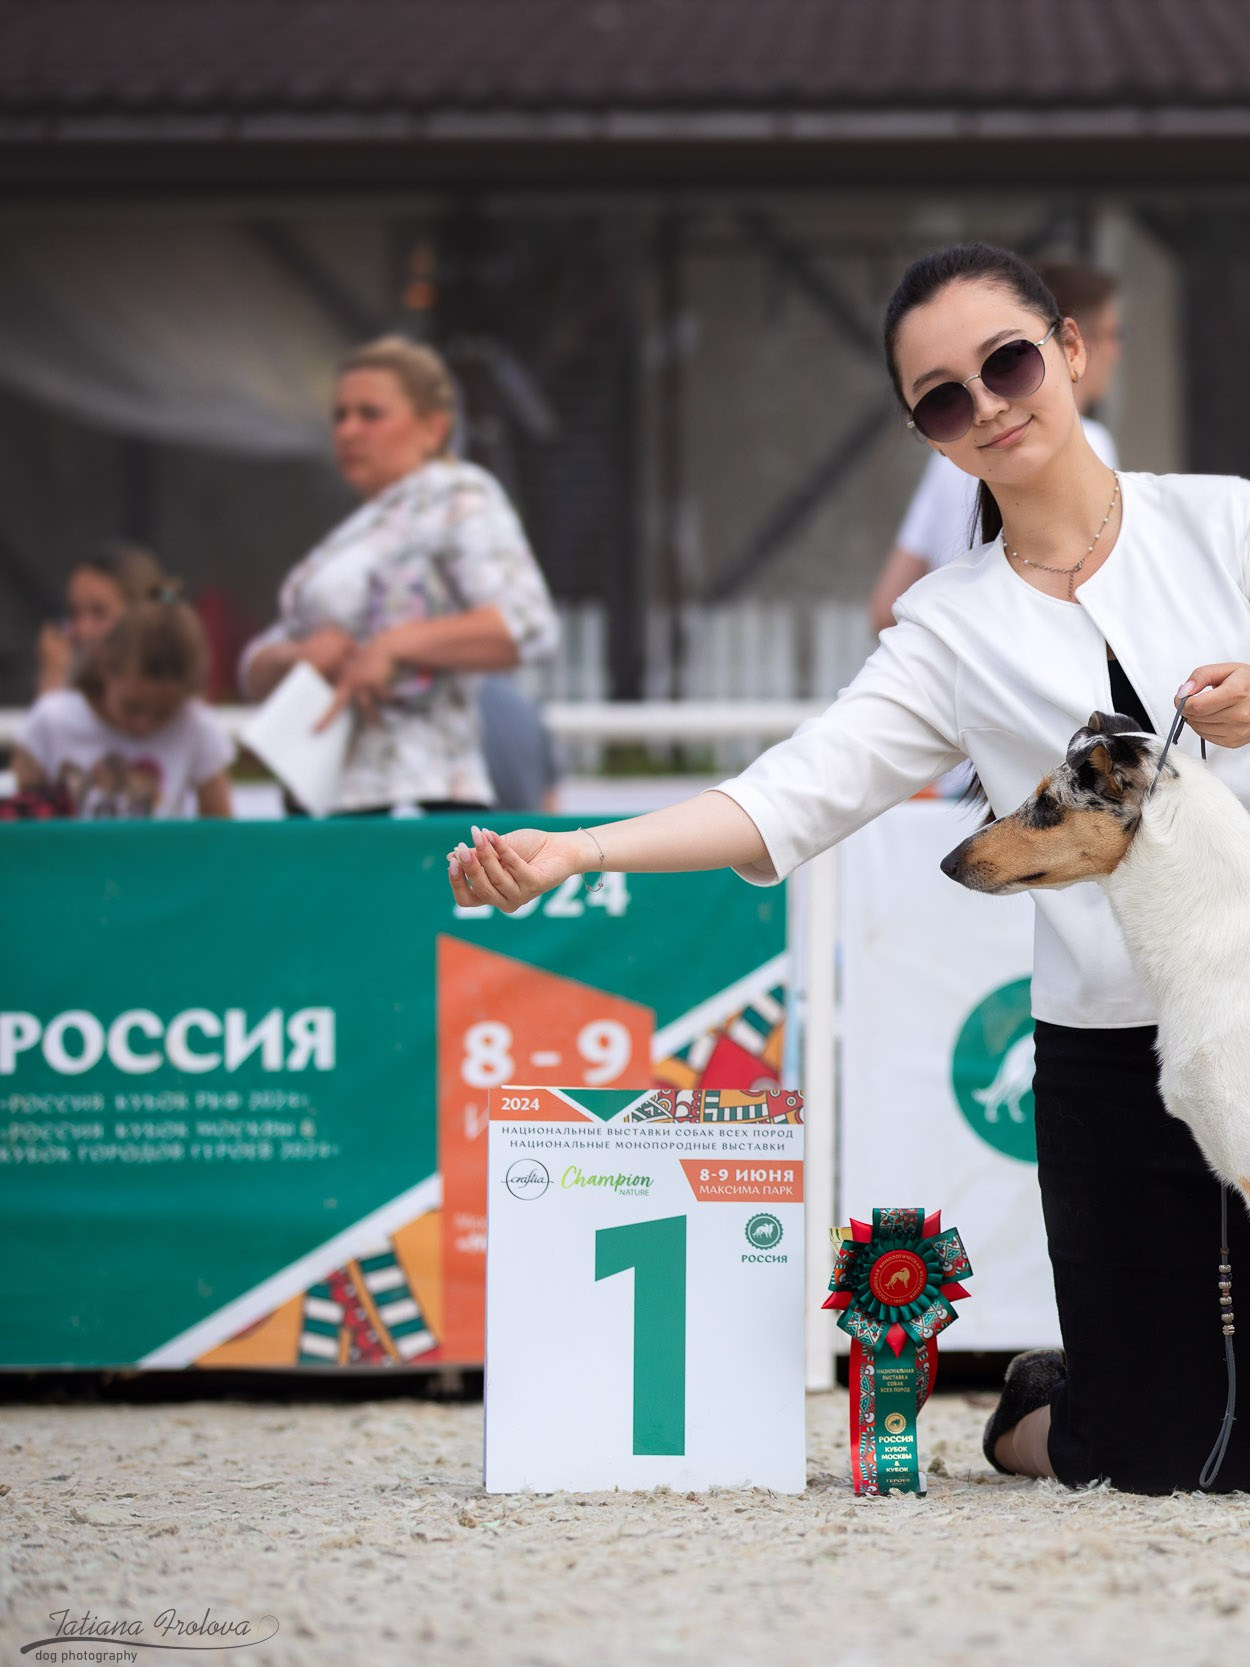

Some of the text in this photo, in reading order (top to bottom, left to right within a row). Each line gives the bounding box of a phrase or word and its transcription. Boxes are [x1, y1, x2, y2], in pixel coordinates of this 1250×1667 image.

[453, 868, 631, 919] 24
[0, 1006, 336, 1075] РОССИЯ
[501, 1097, 540, 1111] 2024
[502, 1127, 794, 1138] НАЦИОНАЛЬНЫЕ ВЫСТАВКИ СОБАК ВСЕХ ПОРОД
[510, 1140, 785, 1151] НАЦИОНАЛЬНЫЕ МОНОПОРОДНЫЕ ВЫСТАВКИ
[561, 1165, 654, 1192] Champion
[699, 1168, 794, 1182] 8-9 ИЮНЯ
[619, 1189, 650, 1197] NATURE
[699, 1185, 793, 1195] МАКСИМА ПАРК
[741, 1254, 788, 1263] РОССИЯ
[595, 1214, 687, 1456] 1
[878, 1435, 914, 1443] РОССИЯ
